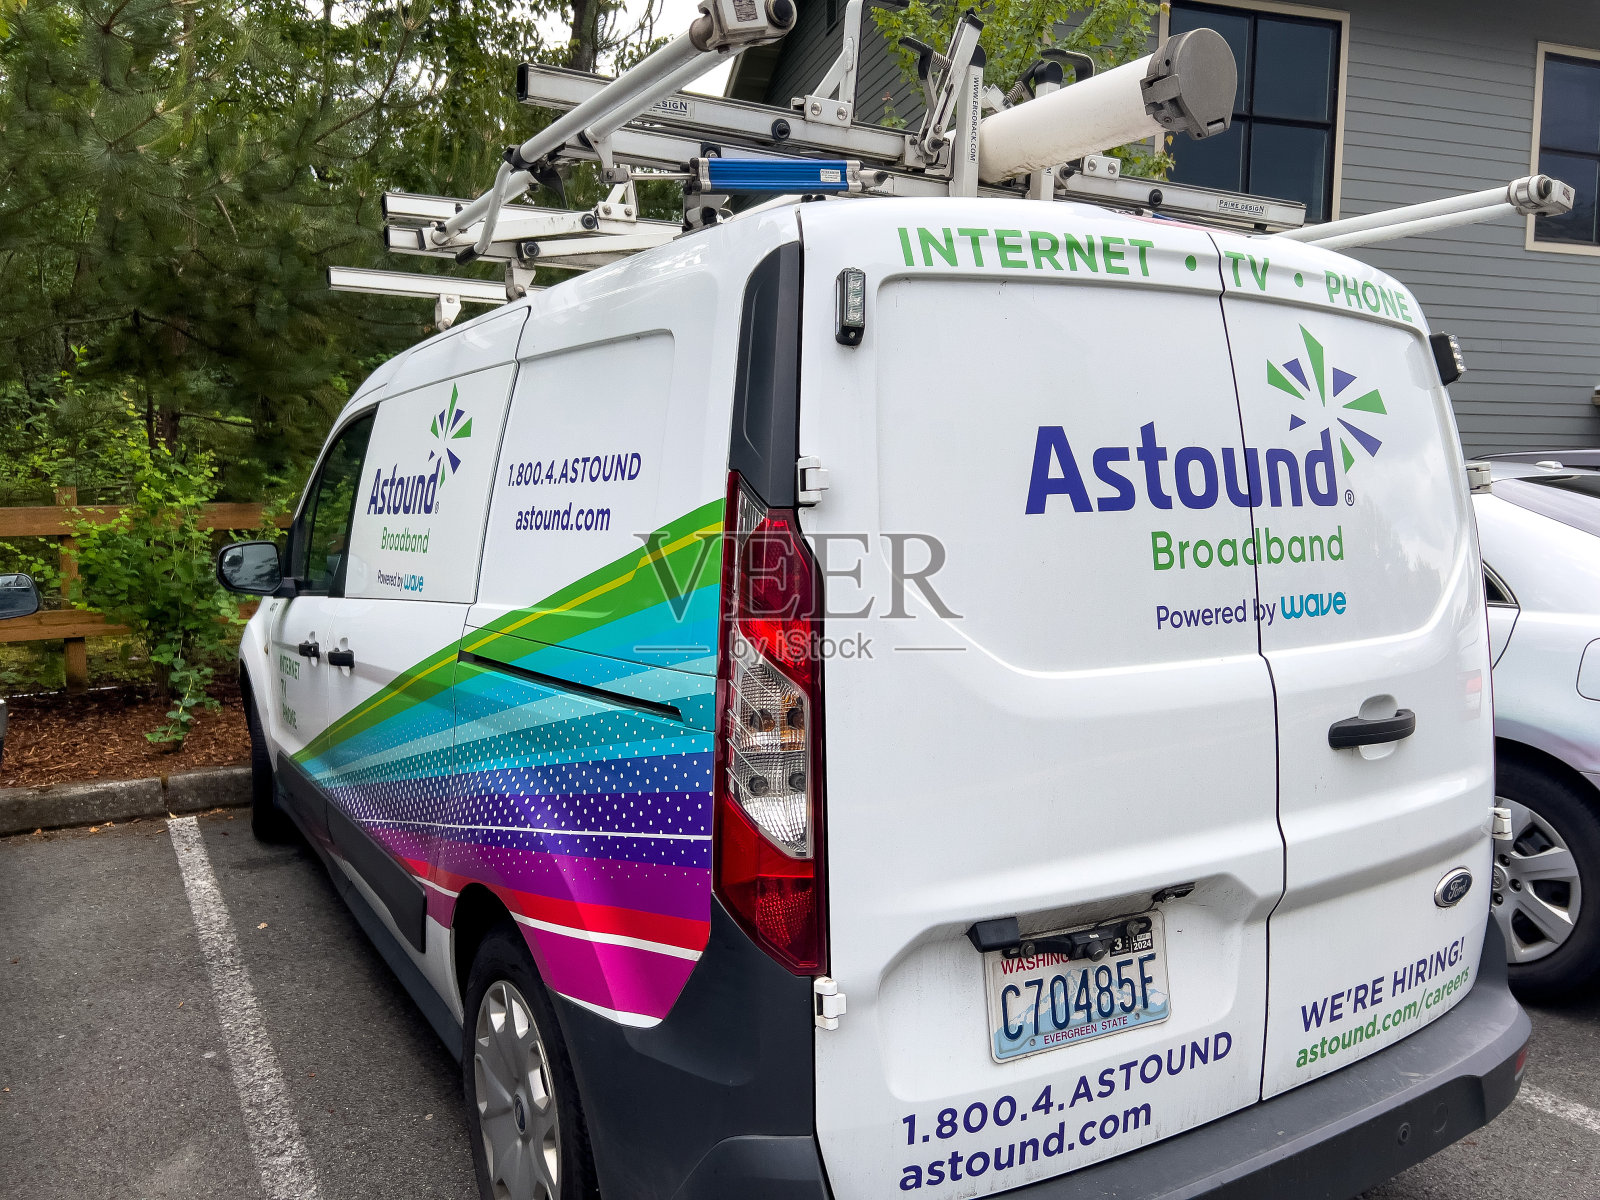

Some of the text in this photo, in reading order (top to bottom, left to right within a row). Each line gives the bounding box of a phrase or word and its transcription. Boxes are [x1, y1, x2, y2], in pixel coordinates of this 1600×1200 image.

[969, 76, 980, 162] WWW.ERGORACK.COM
[897, 227, 1412, 322] INTERNET TV PHONE
[366, 455, 442, 515] Astound
[508, 452, 642, 487] 1.800.4.ASTOUND
[1024, 420, 1339, 515] Astound
[380, 526, 430, 554] Broadband
[515, 501, 611, 531] astound.com
[1151, 525, 1344, 571] Broadband
[377, 569, 397, 586] Powered
[404, 573, 424, 592] wave
[1156, 591, 1347, 630] Powered by wave
[1448, 878, 1468, 900] Ford
[1114, 938, 1123, 950] 3
[1133, 940, 1152, 951] 2024
[1001, 952, 1157, 1041] C70485F
[1301, 936, 1465, 1033] WE'RE HIRING!
[1043, 1015, 1129, 1045] EVERGREEN STATE
[1296, 966, 1470, 1068] astound.com/careers
[902, 1031, 1233, 1145] 1.800.4.ASTOUND
[899, 1102, 1152, 1191] astound.com
